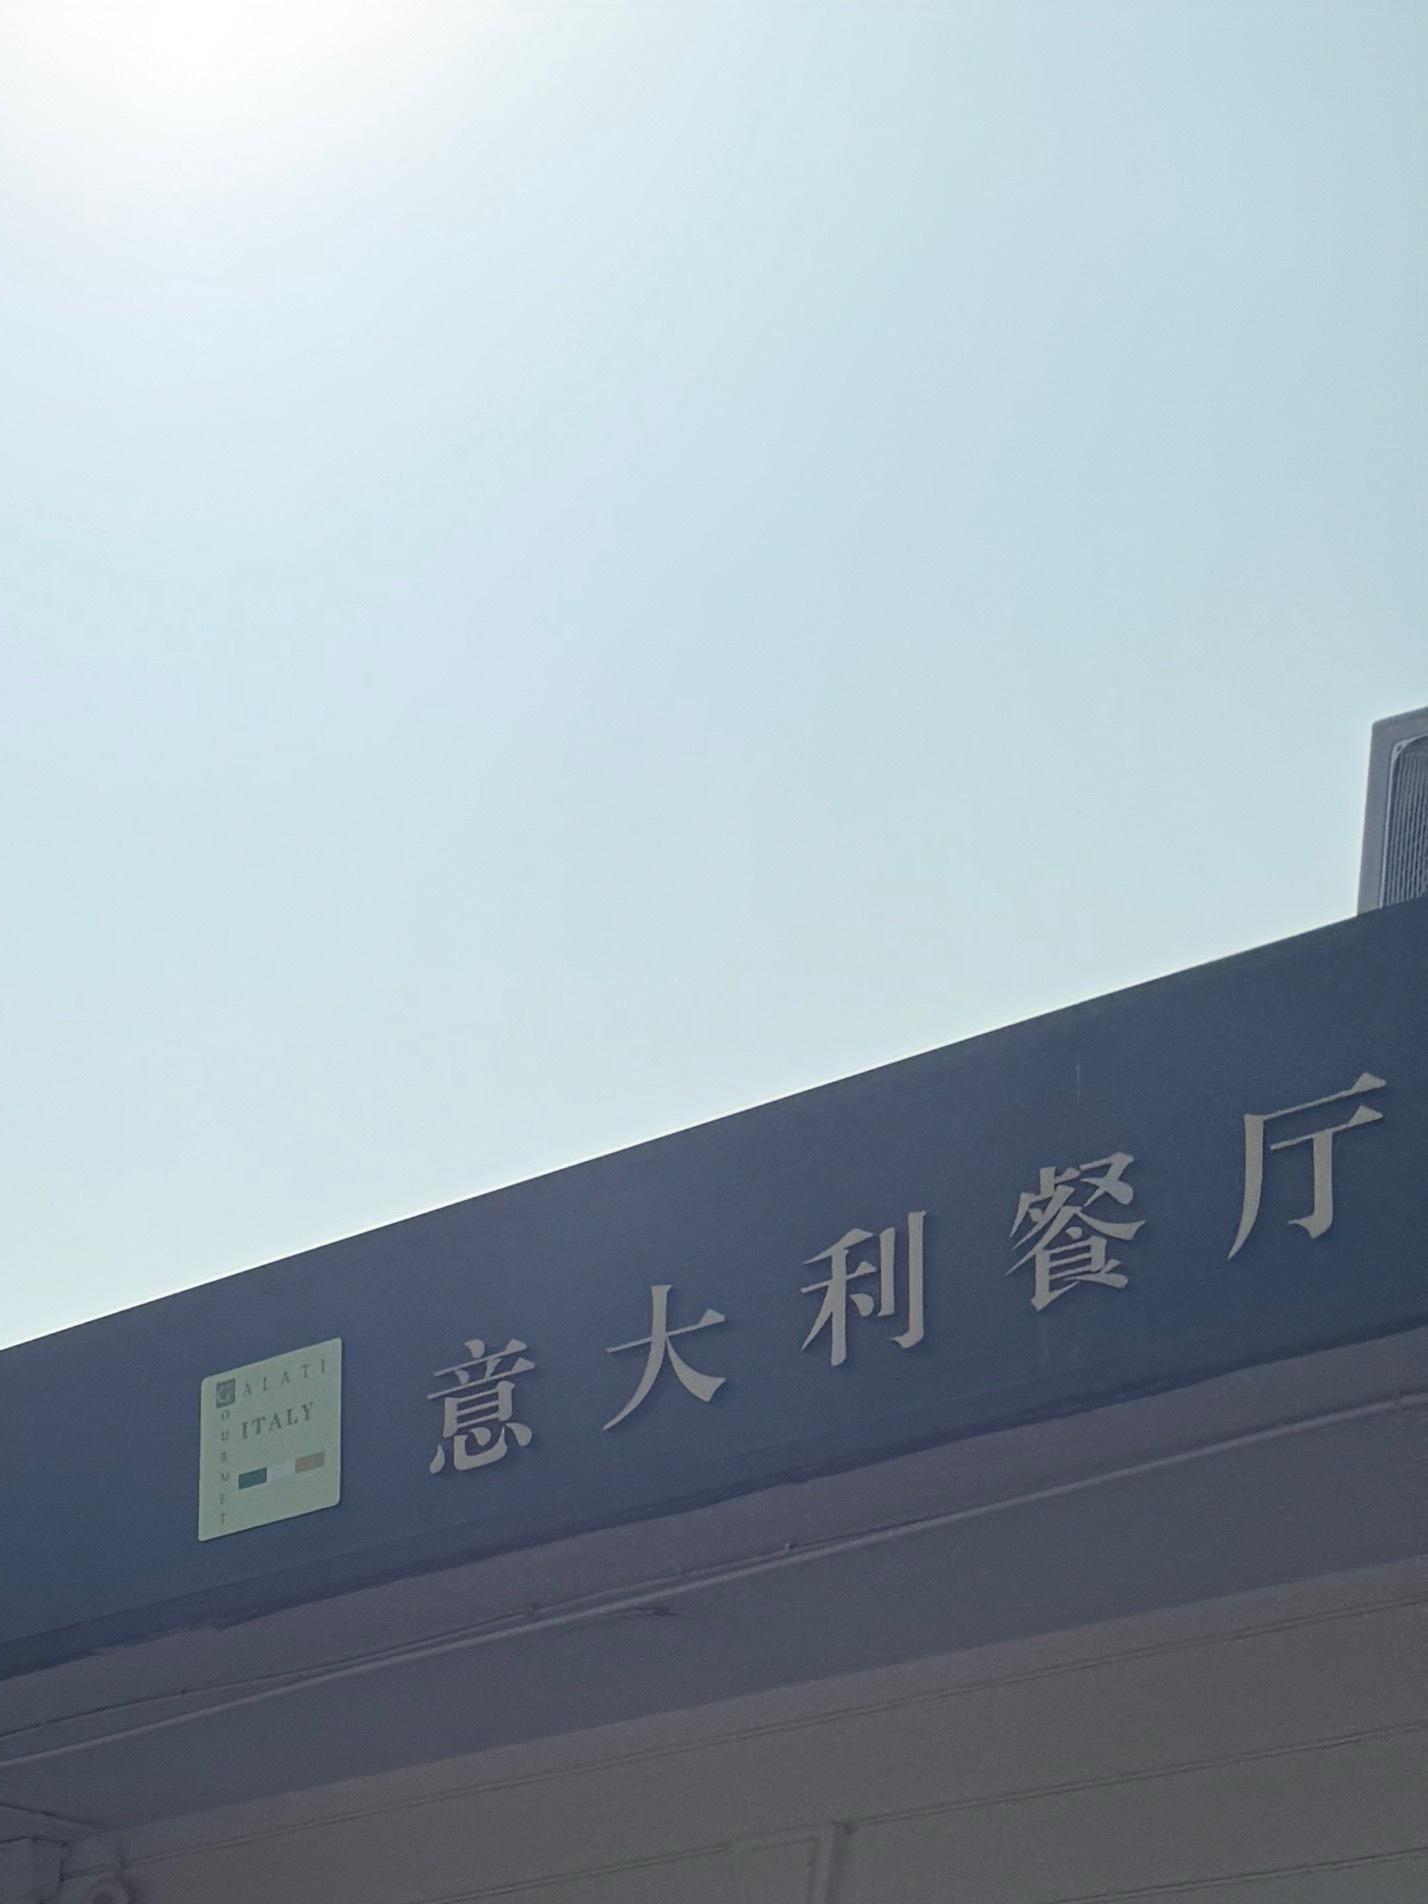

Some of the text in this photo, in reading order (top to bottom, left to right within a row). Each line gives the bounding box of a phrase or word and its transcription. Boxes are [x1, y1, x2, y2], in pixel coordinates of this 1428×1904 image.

[428, 1072, 1386, 1475] 意大利餐厅
[241, 1401, 315, 1440] ITALY
